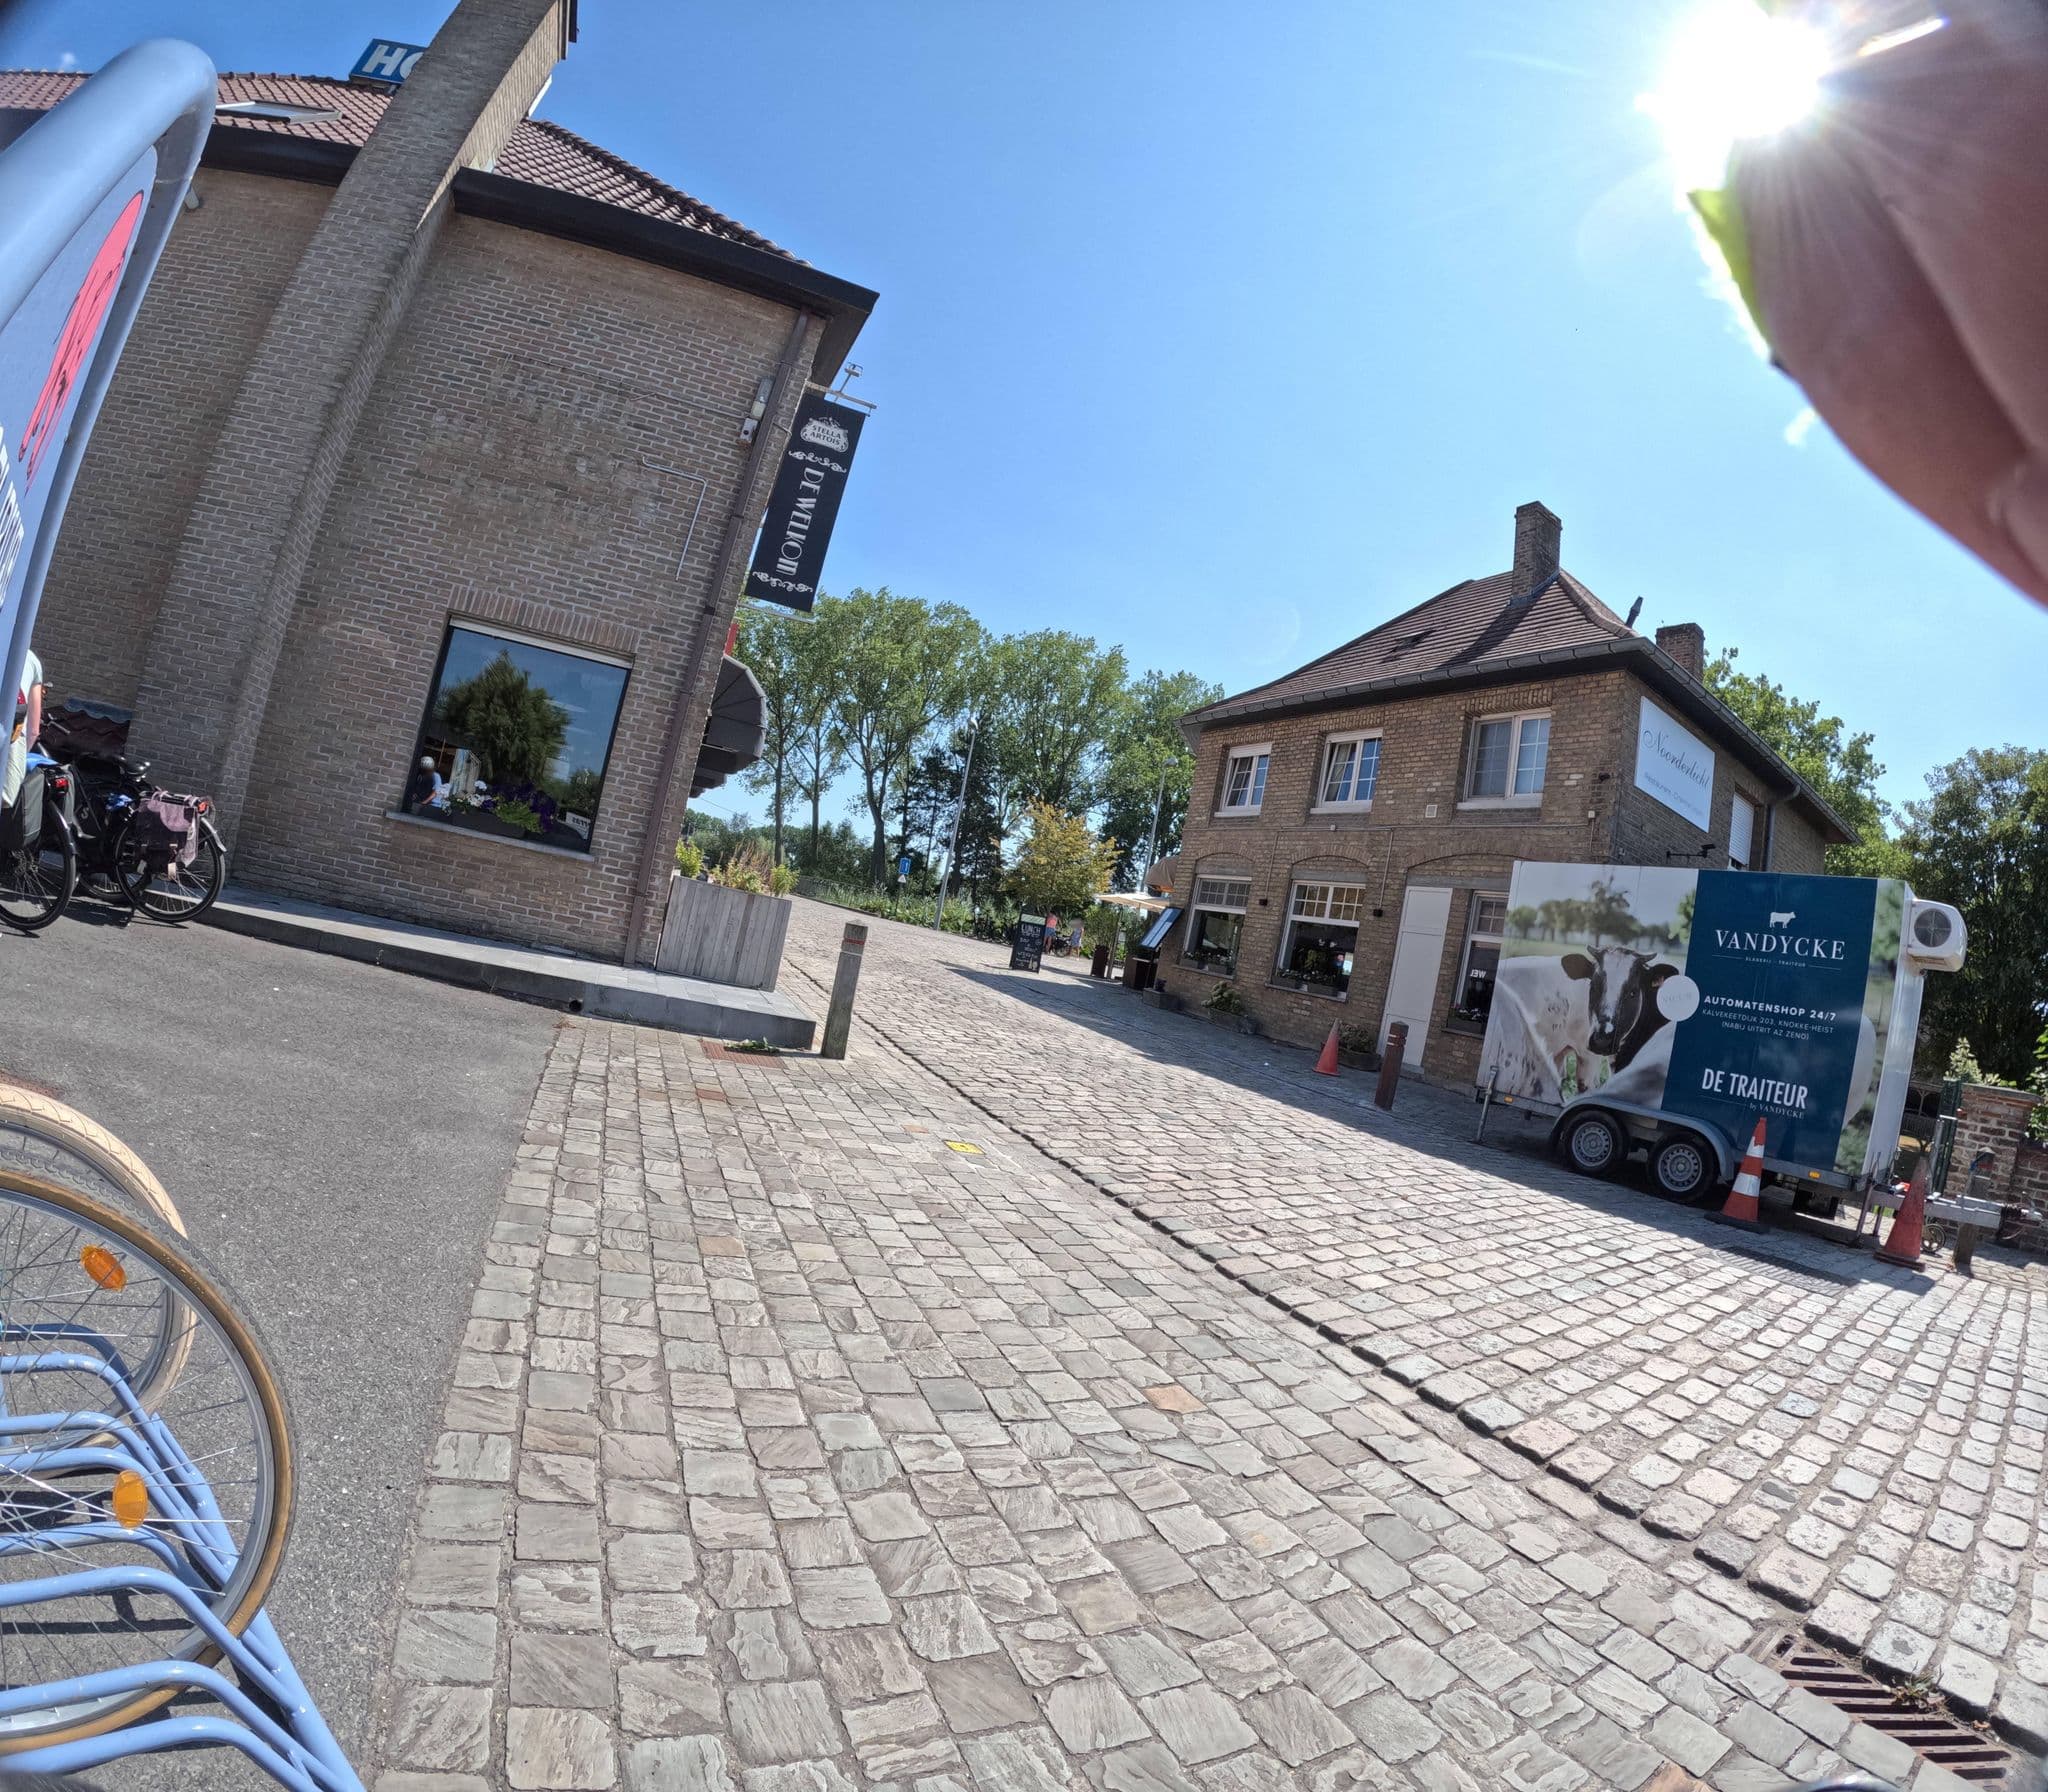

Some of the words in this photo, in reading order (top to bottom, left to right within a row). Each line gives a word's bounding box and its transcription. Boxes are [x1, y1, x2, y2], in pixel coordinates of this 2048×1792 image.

[810, 431, 841, 445] ARTOIS
[812, 424, 841, 439] STELLA
[799, 467, 824, 495] DE
[775, 497, 817, 576] WELKOM
[1643, 730, 1709, 788] Noorderlicht
[1715, 929, 1845, 960] VANDYCKE
[1703, 995, 1806, 1017] AUTOMATENSHOP
[1809, 1009, 1837, 1021] 24/7
[1773, 1028, 1783, 1036] AZ
[1778, 1020, 1834, 1034] KNOKKE-HEIST
[1702, 1068, 1725, 1092] DE
[1729, 1073, 1808, 1109] TRAITEUR
[1749, 1102, 1757, 1112] by
[1759, 1104, 1805, 1119] VANDYCKE
